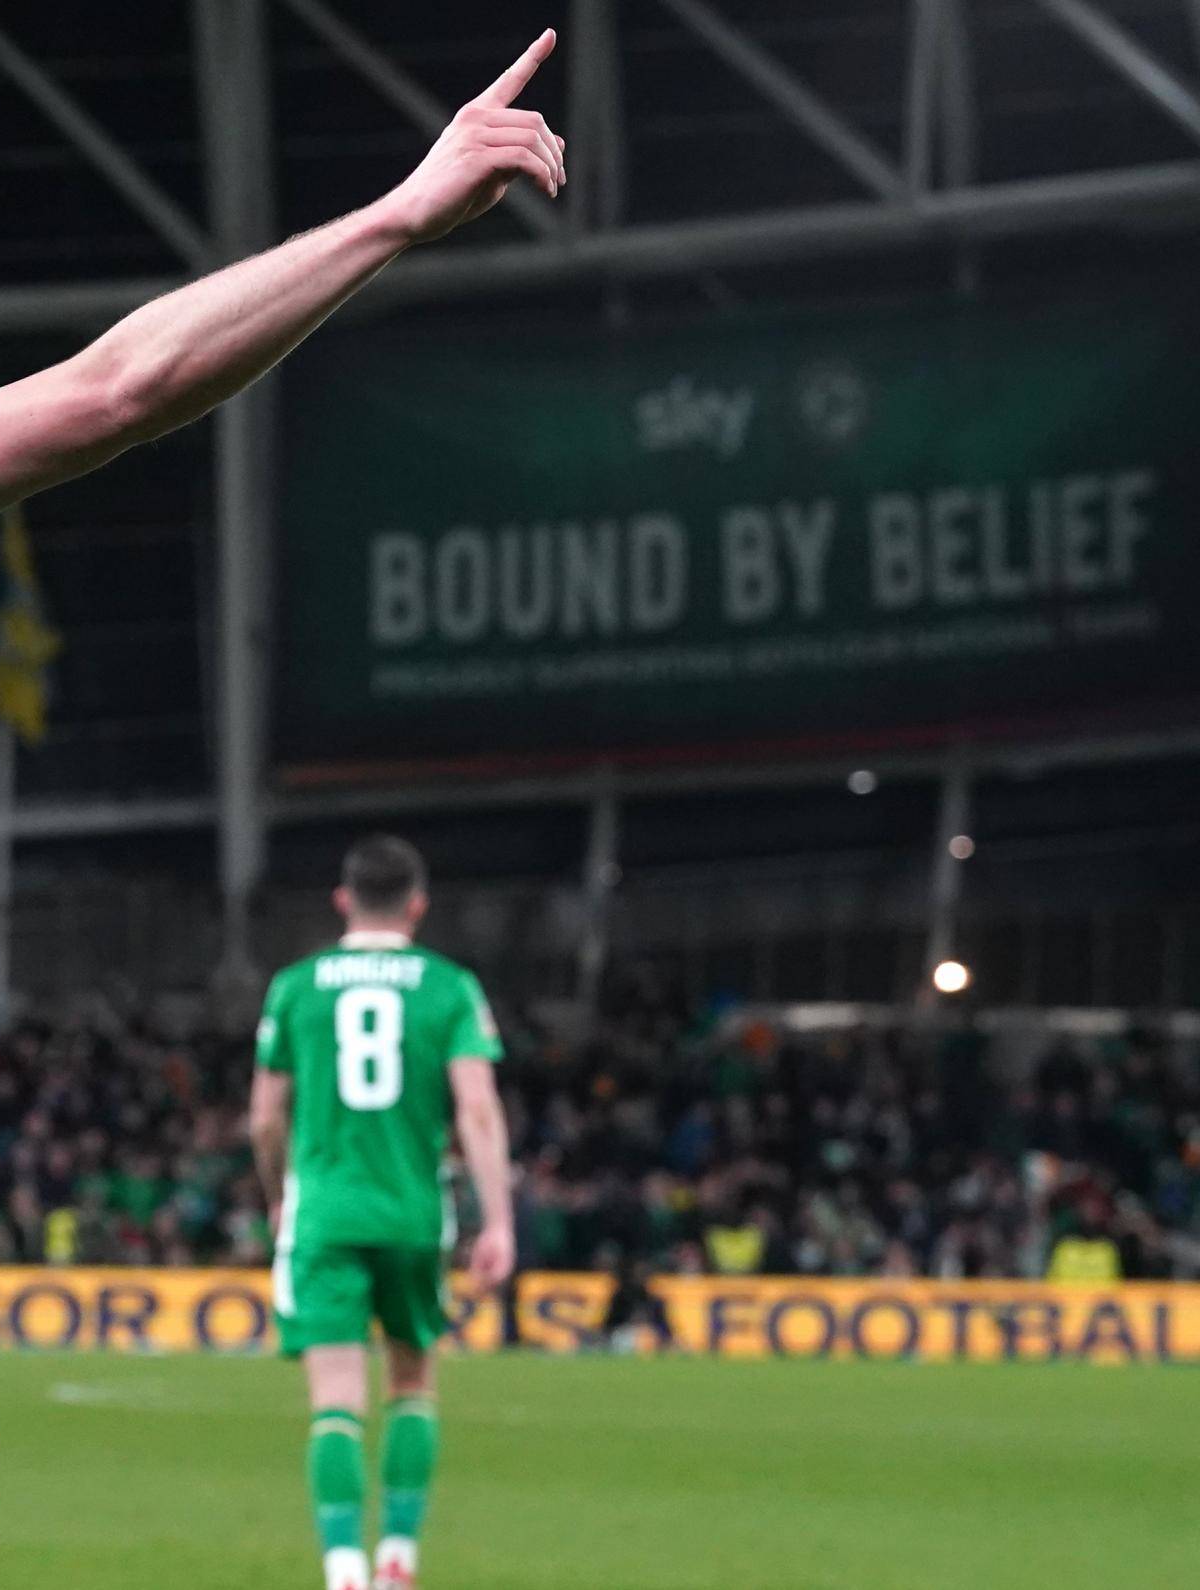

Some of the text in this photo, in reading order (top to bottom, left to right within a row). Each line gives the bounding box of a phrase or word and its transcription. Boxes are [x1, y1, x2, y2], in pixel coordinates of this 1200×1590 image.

[369, 473, 1154, 645] BOUND BY BELIEF
[335, 985, 404, 1111] 8
